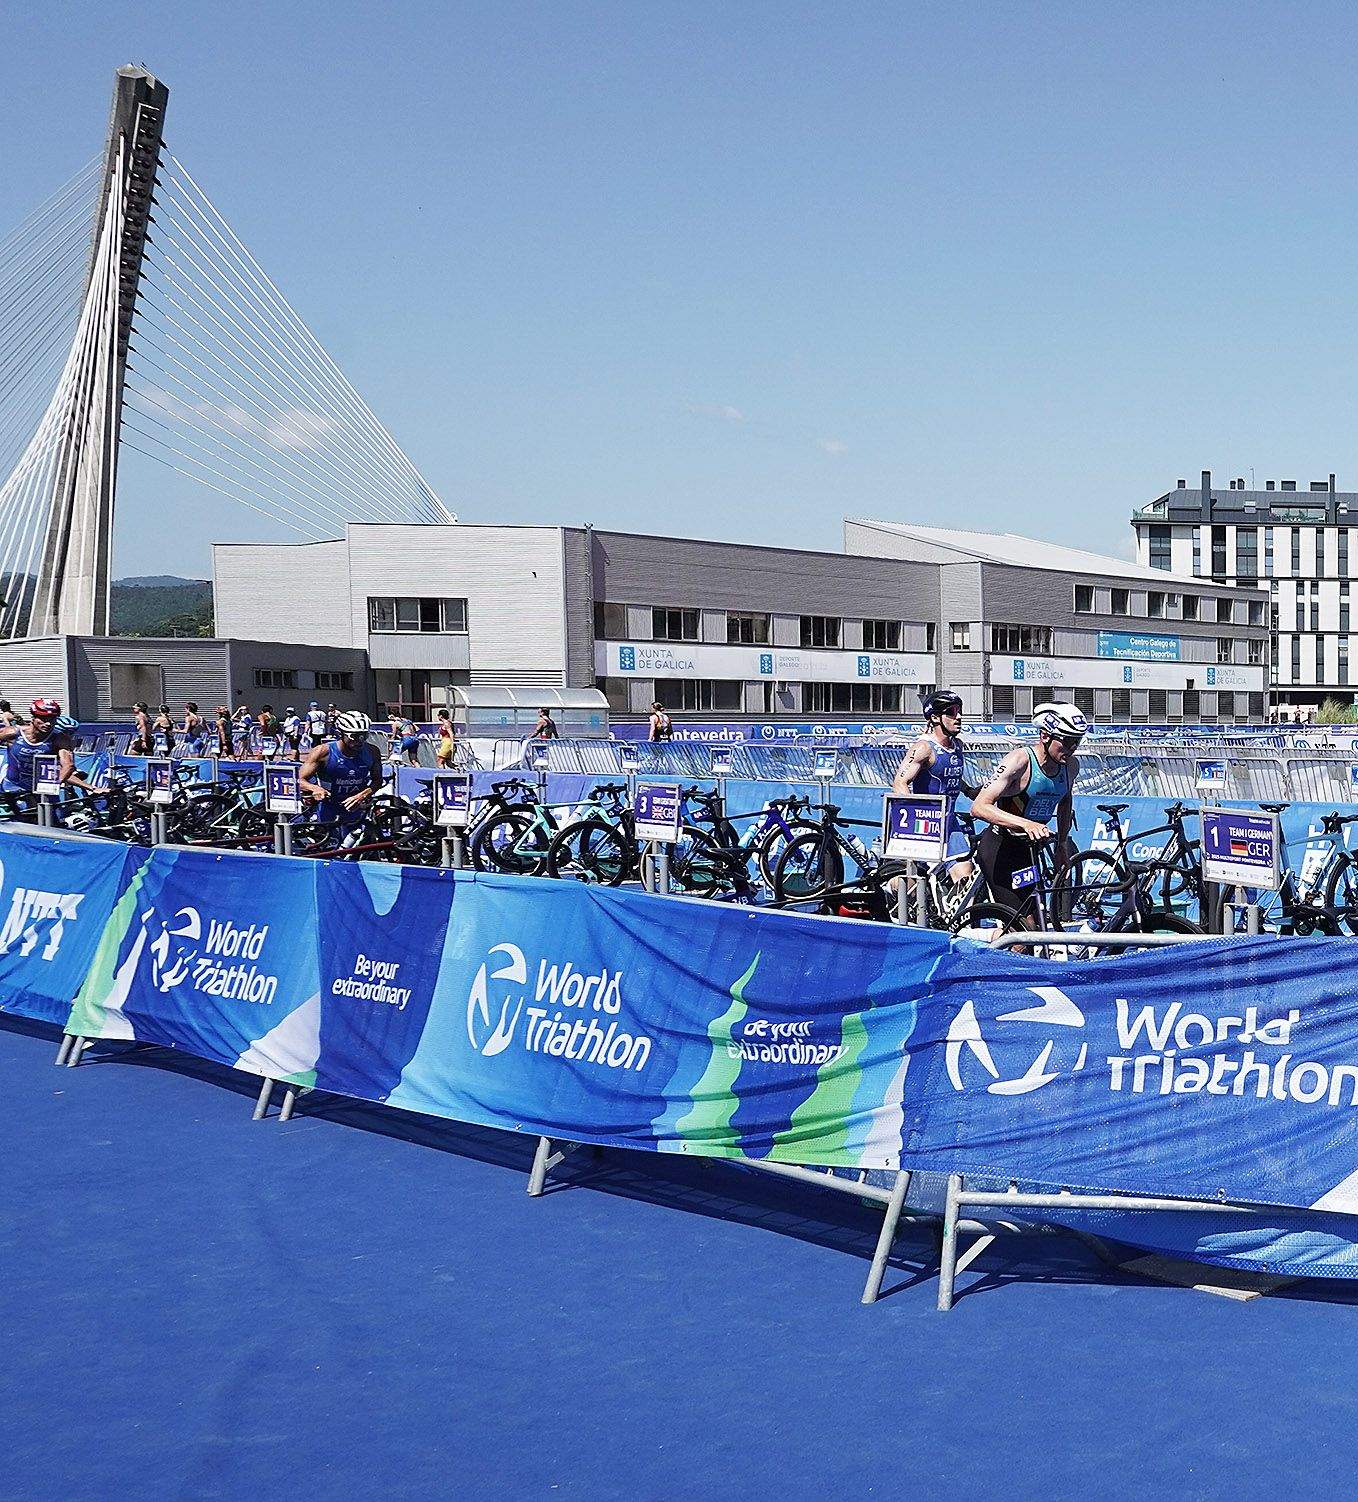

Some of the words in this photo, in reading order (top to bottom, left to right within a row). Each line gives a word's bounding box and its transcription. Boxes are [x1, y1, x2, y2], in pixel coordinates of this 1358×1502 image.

[1130, 637, 1149, 646] Centro
[1149, 639, 1169, 649] Galego
[638, 648, 673, 659] XUNTA
[1150, 650, 1177, 658] Deportiva
[638, 660, 652, 669] DE
[654, 661, 695, 670] GALICIA
[873, 658, 900, 666] XUNTA
[1026, 662, 1050, 670] XUNTA
[873, 667, 883, 676] DE
[885, 667, 917, 676] GALICIA
[1026, 670, 1036, 679] DE
[1037, 671, 1064, 680] GALICIA
[1217, 669, 1236, 677] XUNTA
[1216, 676, 1225, 684] DE
[1226, 677, 1247, 685] GALICIA
[670, 727, 744, 741] ntevedra
[777, 729, 798, 738] NTT
[826, 728, 848, 736] NTT
[975, 727, 992, 735] NTT
[1019, 727, 1038, 735] NTT
[1204, 768, 1210, 777] 5
[273, 777, 279, 791] 5
[639, 796, 648, 814] 3
[899, 808, 908, 828] 2
[1029, 808, 1053, 817] BEL
[929, 821, 941, 834] ITA
[1229, 827, 1245, 838] TEAM
[1247, 829, 1273, 840] GERMANY
[1210, 826, 1219, 848] 1
[1248, 842, 1271, 857] GER
[0, 888, 85, 961] NTT
[206, 918, 269, 961] World
[354, 953, 371, 976] Be
[369, 960, 400, 981] your
[192, 957, 279, 1005] Triathlon
[535, 958, 623, 1015] World
[331, 975, 412, 1011] extraordinary
[769, 1020, 814, 1041] your
[1115, 998, 1300, 1051] World
[525, 1006, 652, 1072] Triathlon
[726, 1038, 850, 1067] extraordinary
